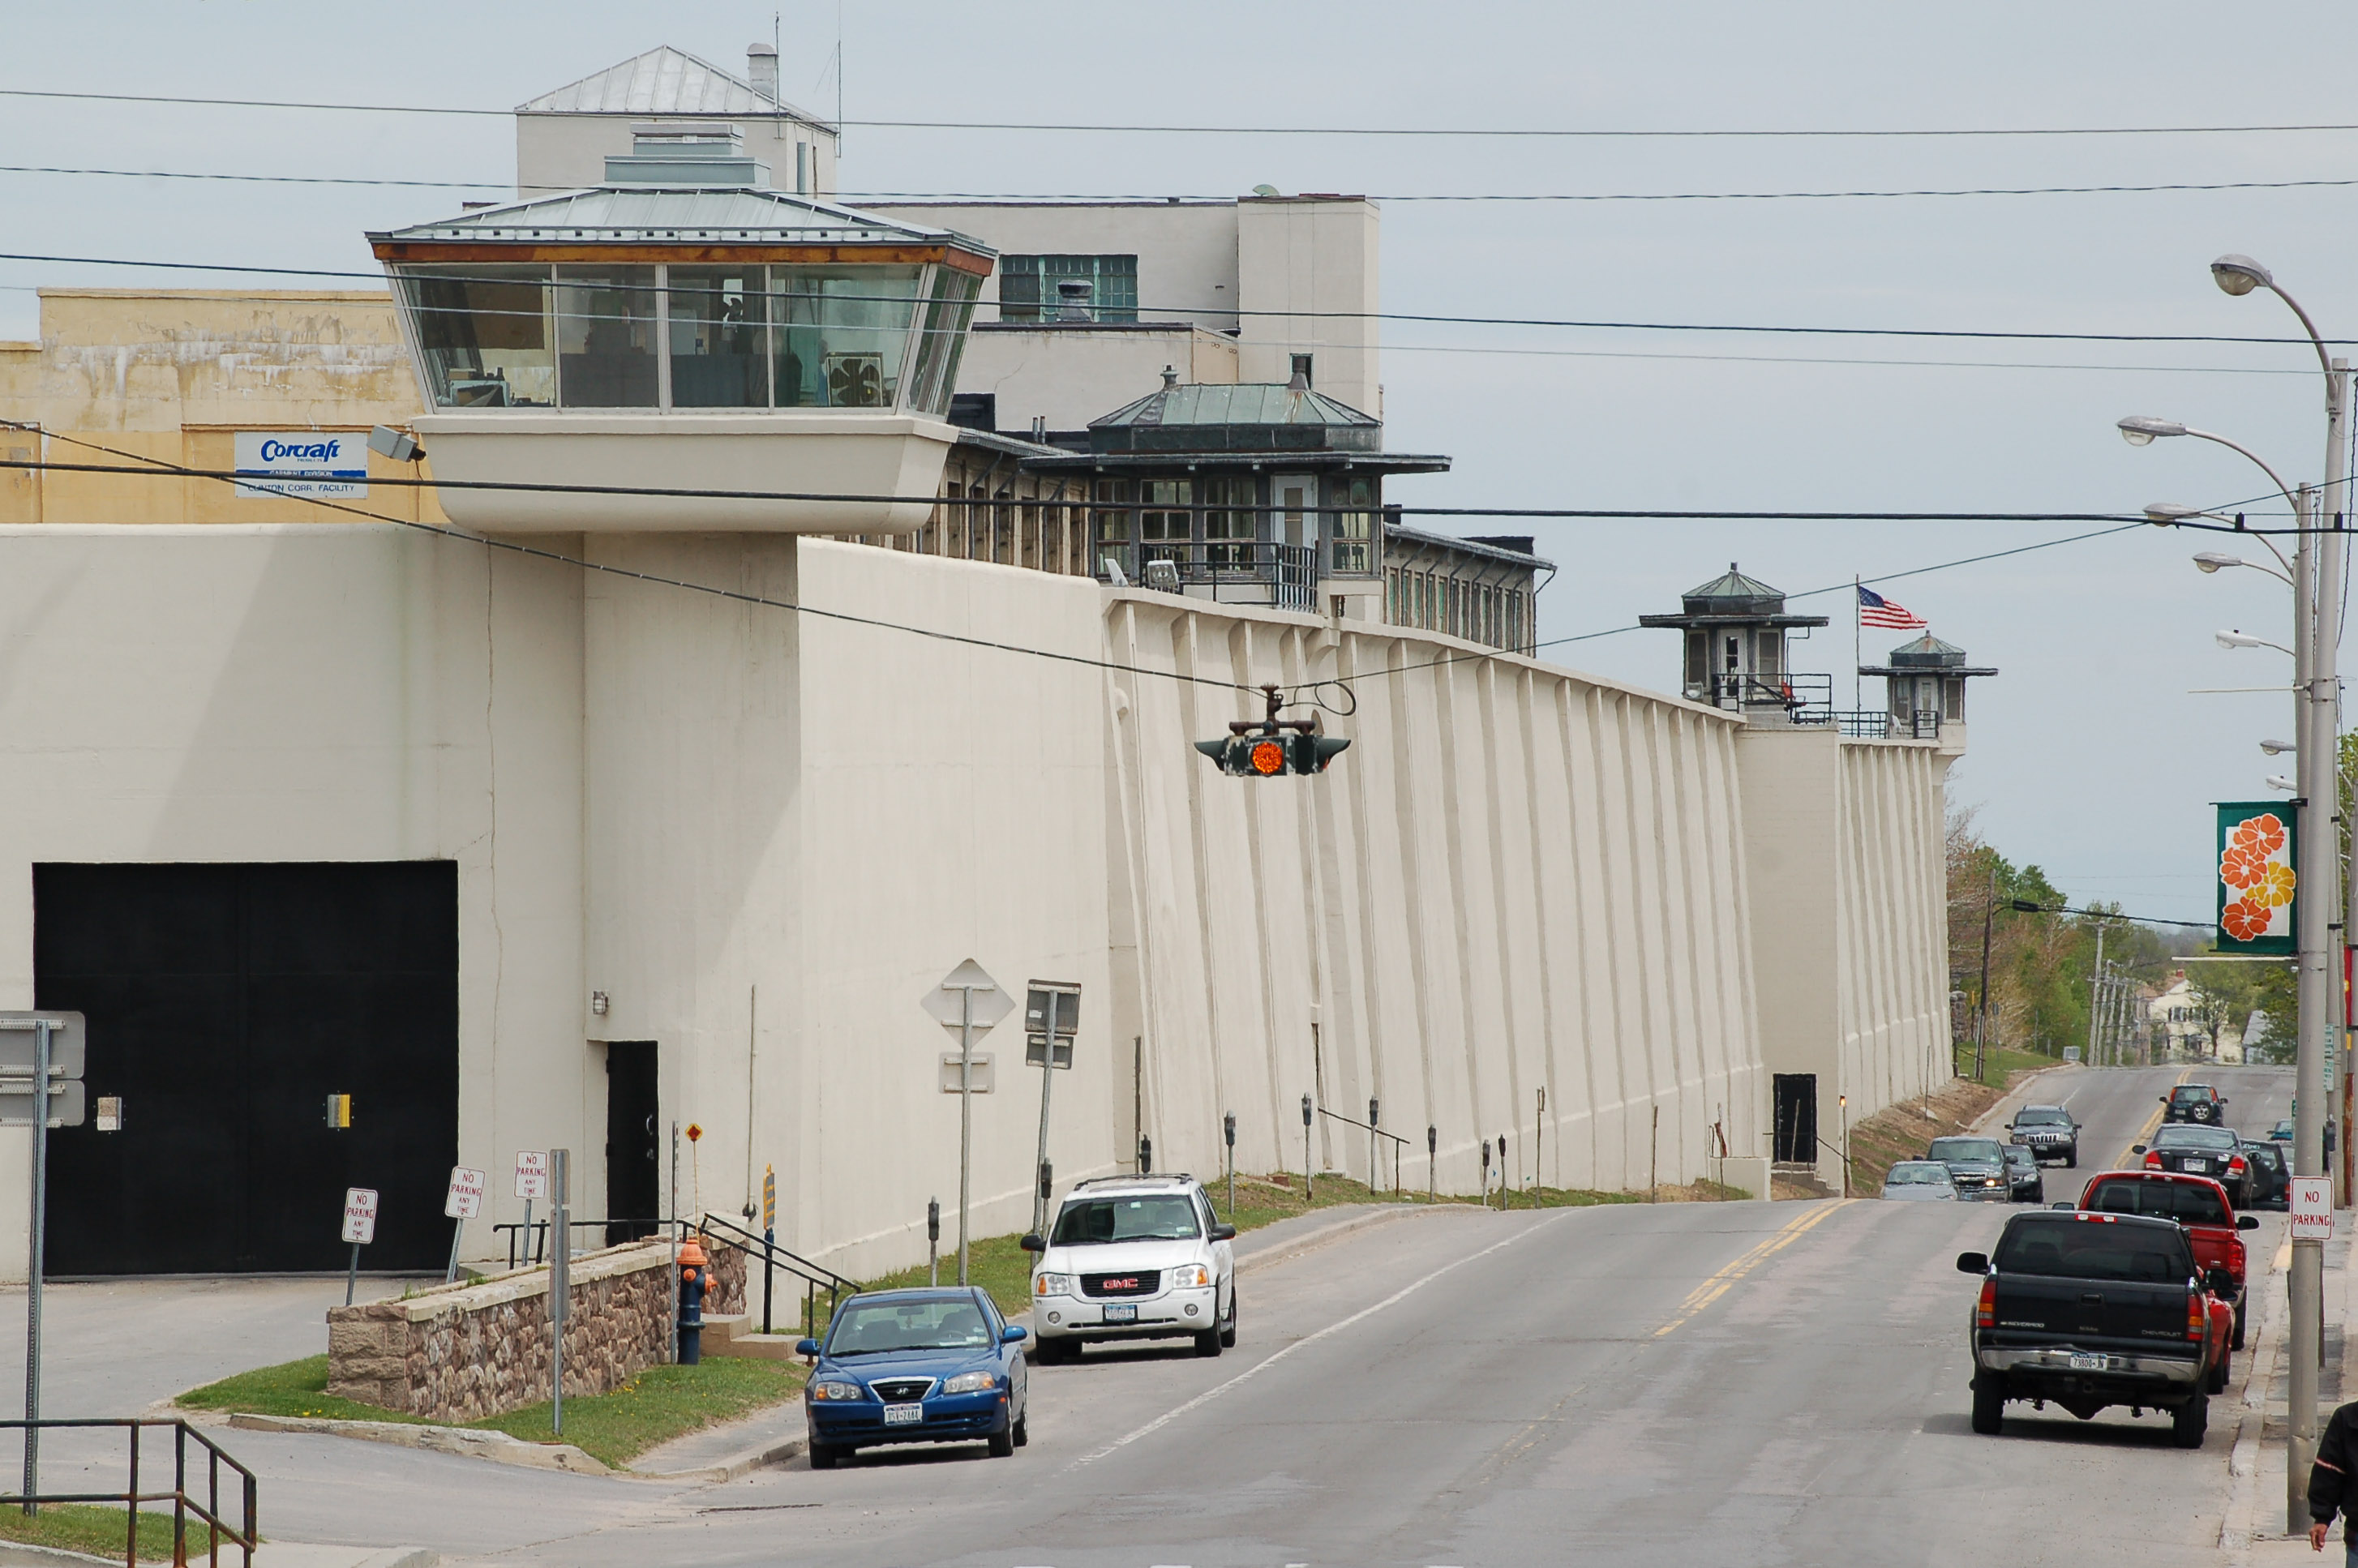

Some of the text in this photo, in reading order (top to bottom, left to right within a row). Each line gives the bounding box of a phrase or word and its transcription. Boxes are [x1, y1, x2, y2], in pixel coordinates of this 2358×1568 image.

[261, 439, 341, 462] Corcraft
[319, 484, 354, 492] FACILITY
[526, 1155, 538, 1165] NO
[517, 1167, 547, 1176] PARKING
[462, 1173, 474, 1183] NO
[451, 1184, 482, 1196] PARKING
[356, 1194, 367, 1206] NO
[2304, 1190, 2320, 1203] NO
[346, 1207, 374, 1219] PARKING
[2293, 1214, 2330, 1227] PARKING
[1103, 1278, 1138, 1289] GMC
